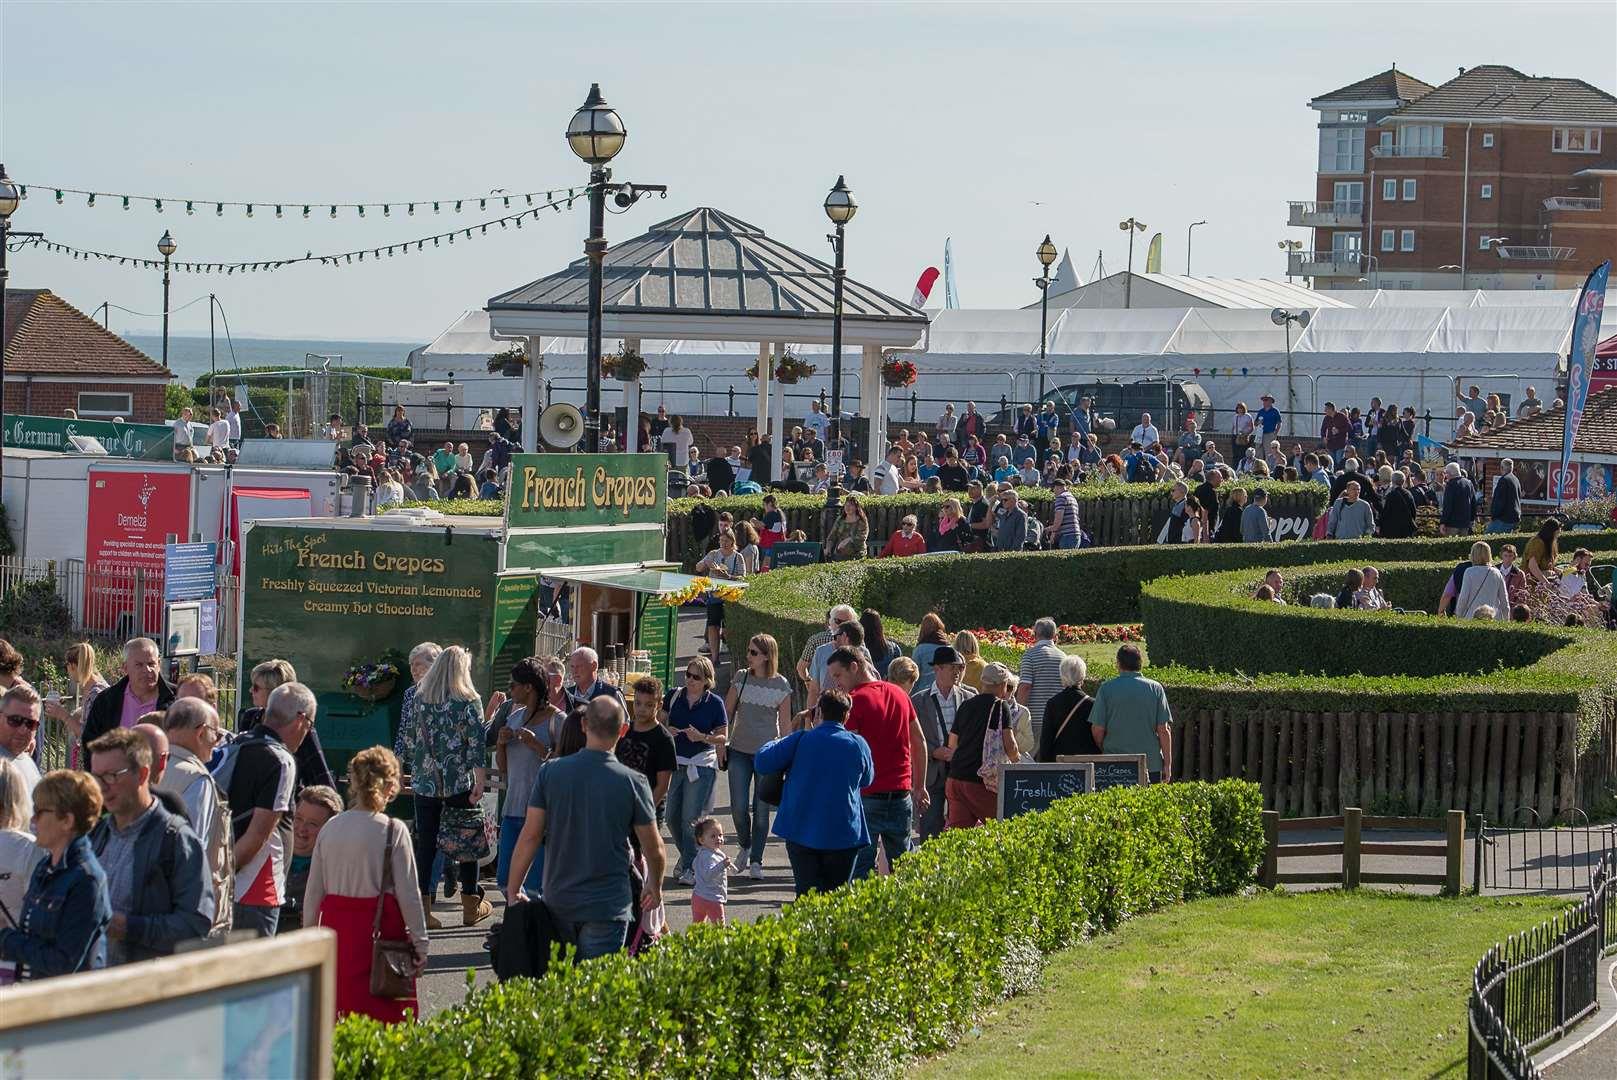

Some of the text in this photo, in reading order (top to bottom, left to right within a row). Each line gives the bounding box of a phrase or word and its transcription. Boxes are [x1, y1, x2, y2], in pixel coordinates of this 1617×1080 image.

[14, 419, 61, 446] German
[64, 424, 119, 453] Sage
[521, 465, 656, 516] French Crepes
[118, 513, 147, 527] Demelza
[283, 538, 302, 551] The
[304, 533, 328, 550] Spot
[297, 549, 446, 576] French Crepes
[261, 578, 482, 598] Freshly Squeezed Victorian Lemonade
[304, 600, 350, 614] Creamy
[375, 603, 434, 617] Chocolate
[1014, 779, 1058, 799] Freshly
